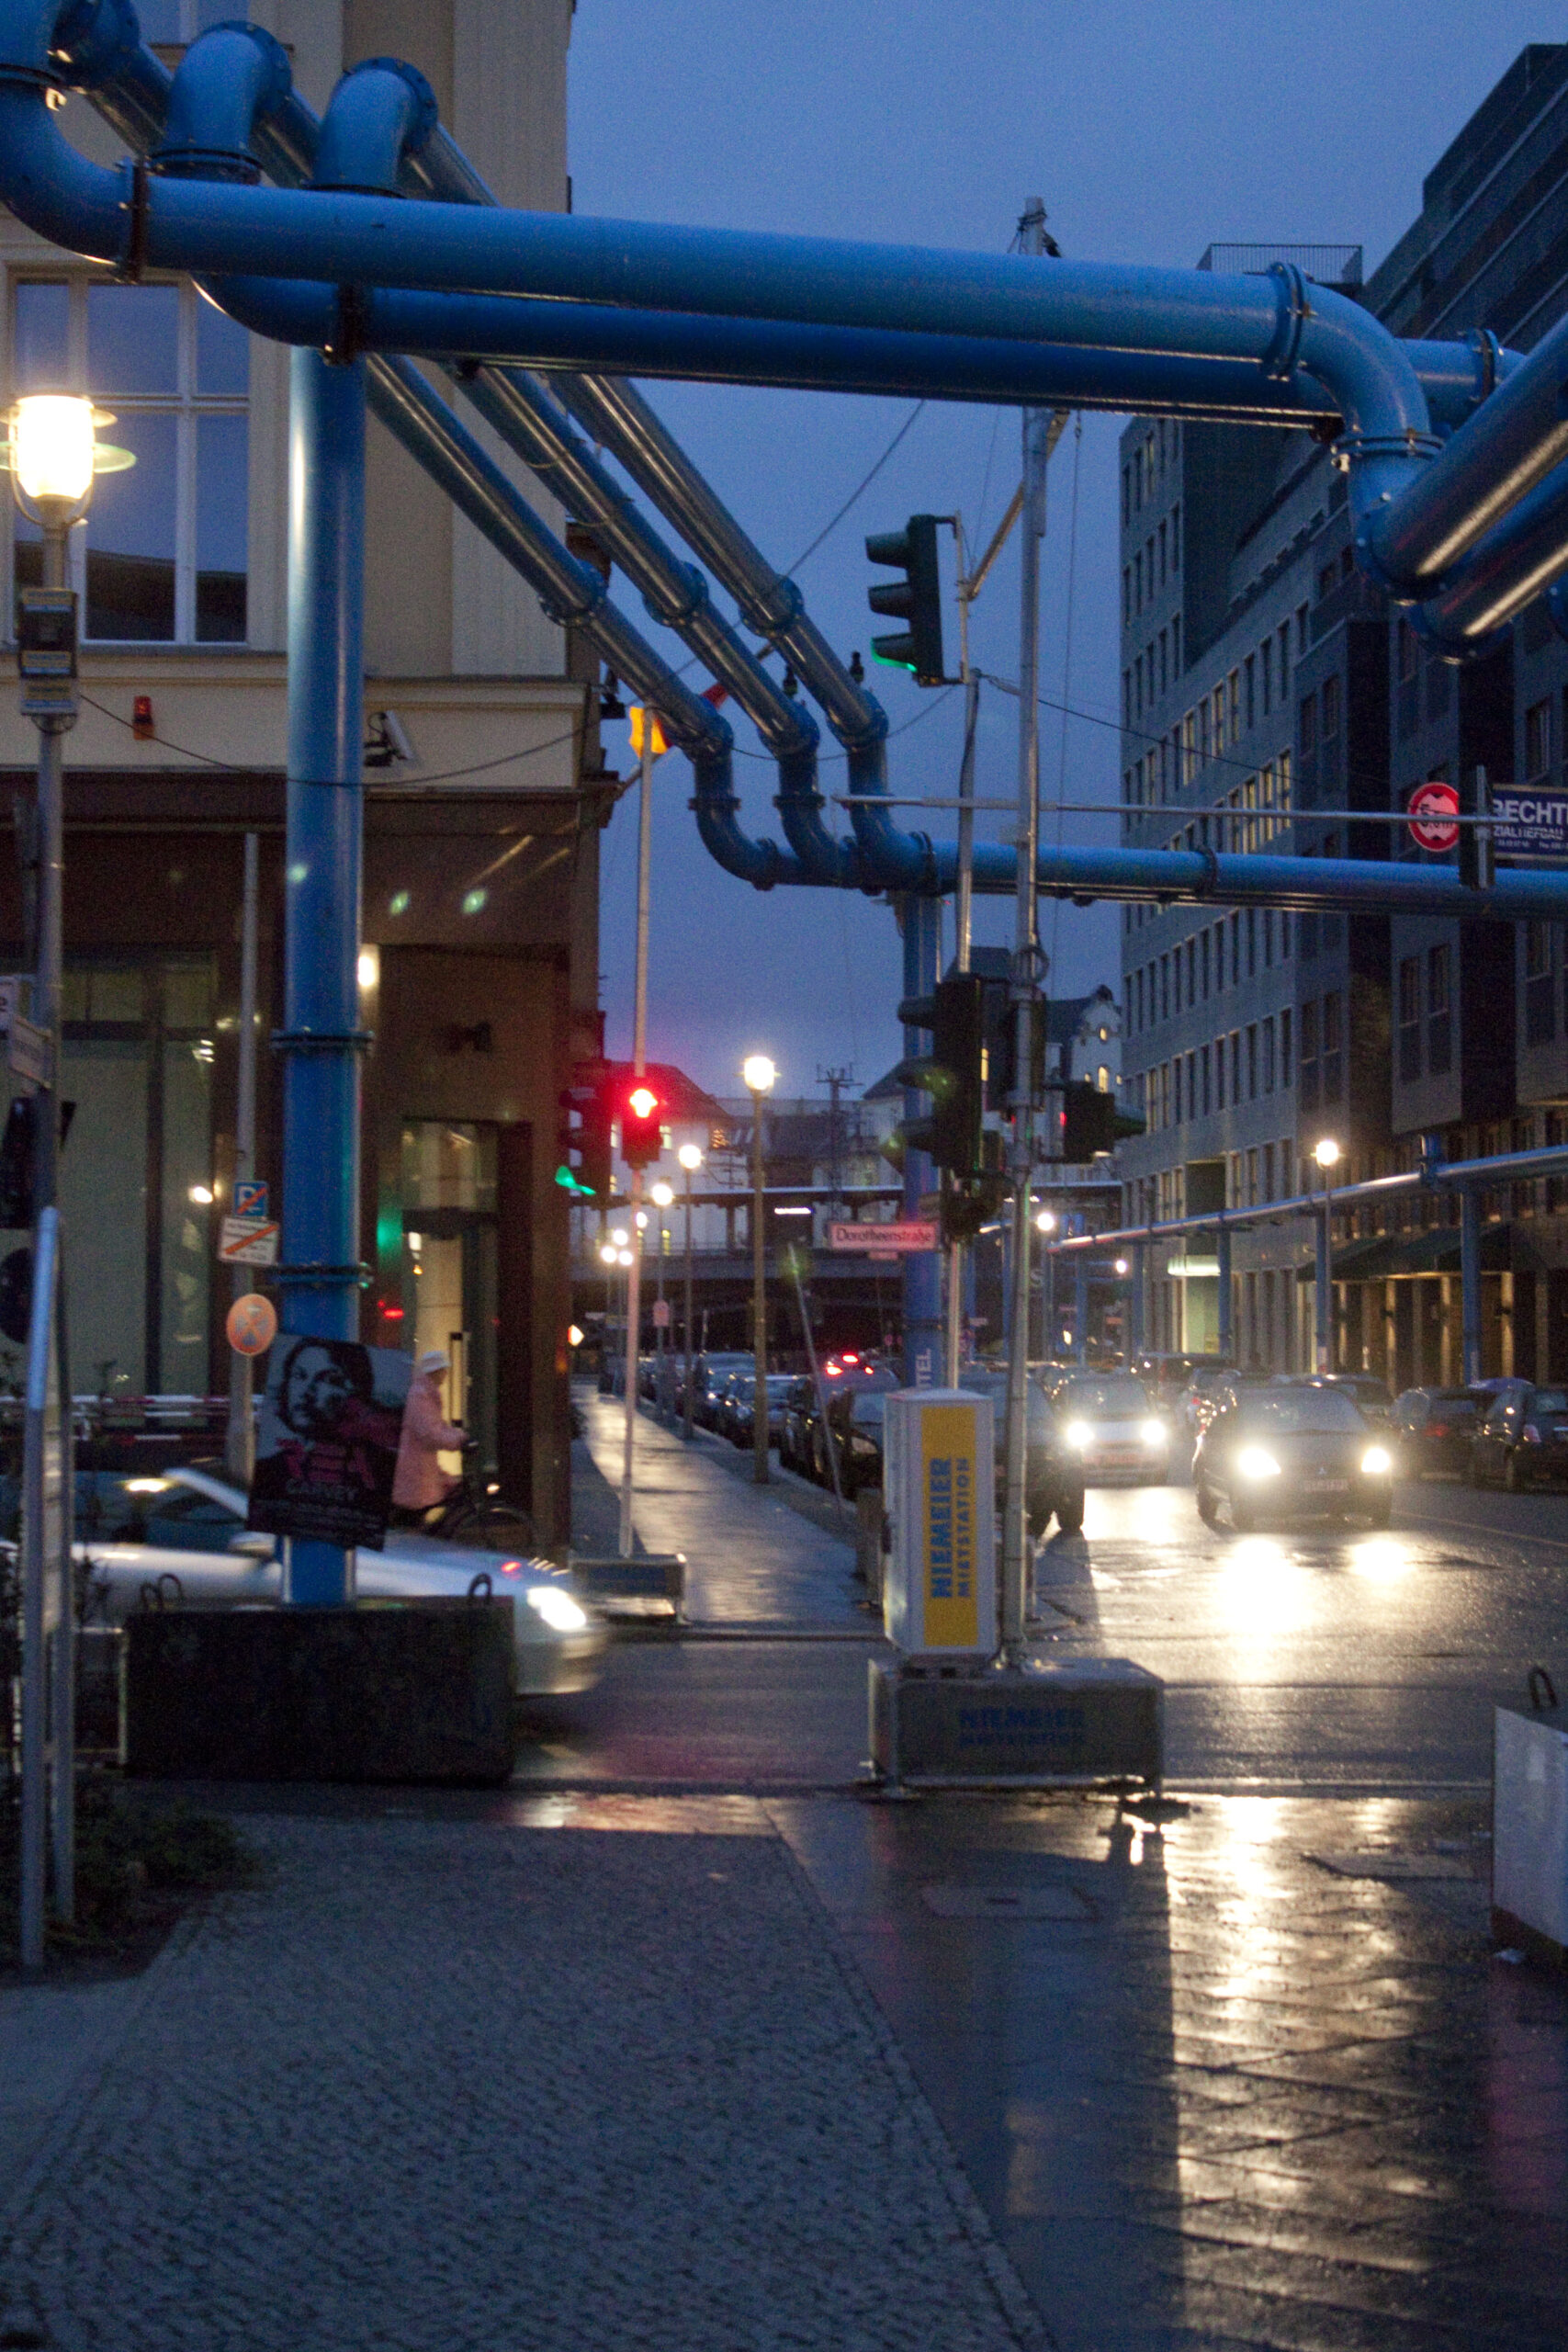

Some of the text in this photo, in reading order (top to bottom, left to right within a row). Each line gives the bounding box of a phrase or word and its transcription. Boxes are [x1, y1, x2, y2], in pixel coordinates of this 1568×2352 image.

[837, 1227, 931, 1245] Dorotheenstraße
[929, 1457, 953, 1598] NIEMEIER
[956, 1458, 971, 1598] MIETSTATION
